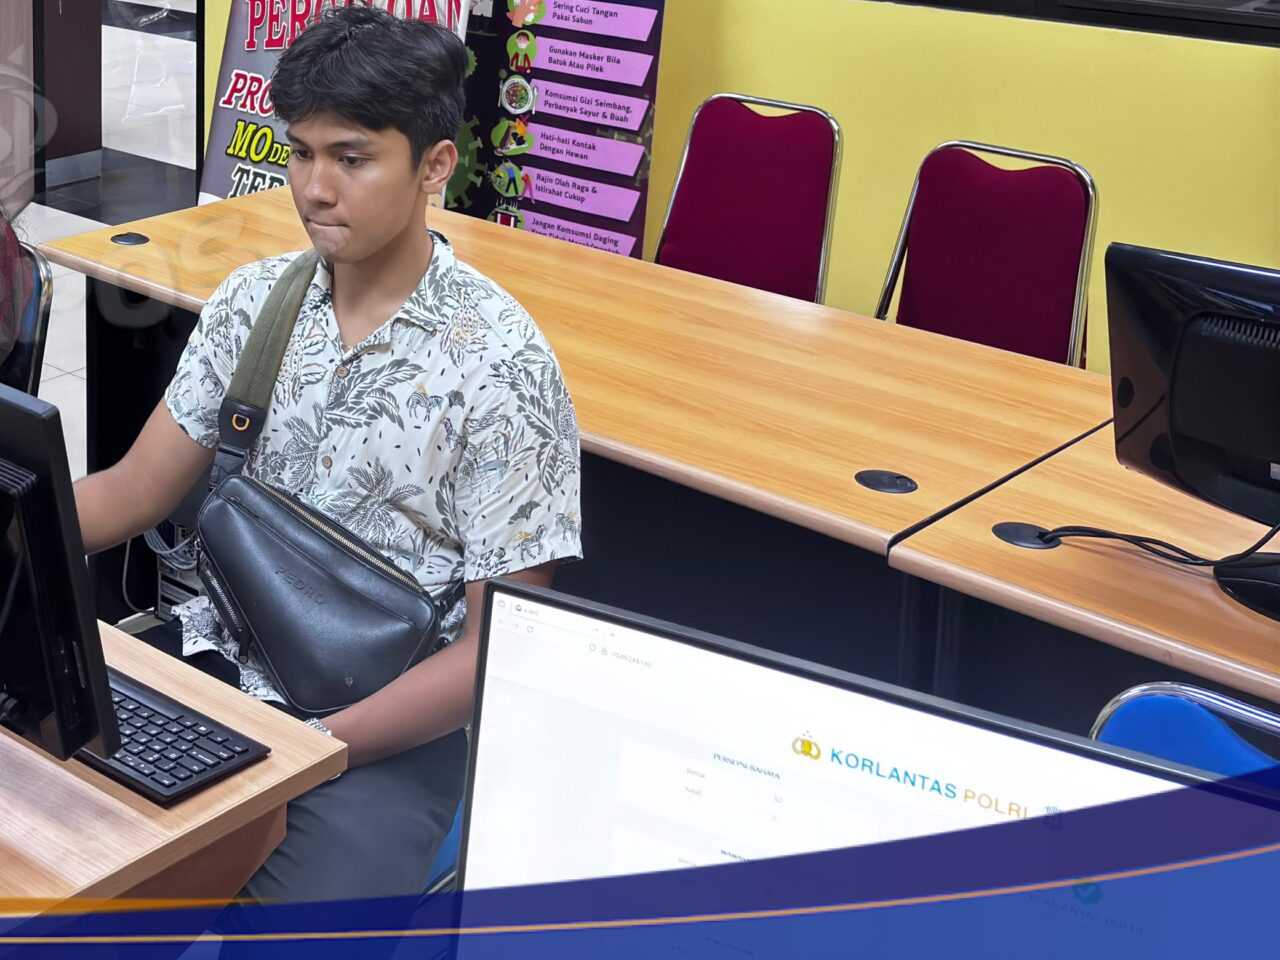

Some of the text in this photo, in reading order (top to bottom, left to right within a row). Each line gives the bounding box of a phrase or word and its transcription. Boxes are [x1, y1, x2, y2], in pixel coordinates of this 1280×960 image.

[553, 0, 618, 18] Sering Cuci Tangan
[552, 12, 593, 25] Pakai Sabun
[548, 46, 621, 64] Gunakan Masker Bila
[548, 56, 604, 73] Batuk Atau Pilek
[579, 96, 593, 105] Gizi
[544, 100, 578, 113] Perbanyak
[579, 107, 600, 117] Sayur
[609, 112, 629, 123] Buah
[540, 131, 596, 150] Hati-hati Kontak
[540, 142, 564, 155] Dengan
[536, 173, 554, 185] Rajin
[555, 178, 570, 188] Olah
[572, 181, 589, 193] Raga
[535, 184, 586, 203] Istirahat Cukup
[532, 218, 556, 230] Jangan
[593, 233, 619, 247] Daging
[830, 747, 958, 799] KORLANTAS
